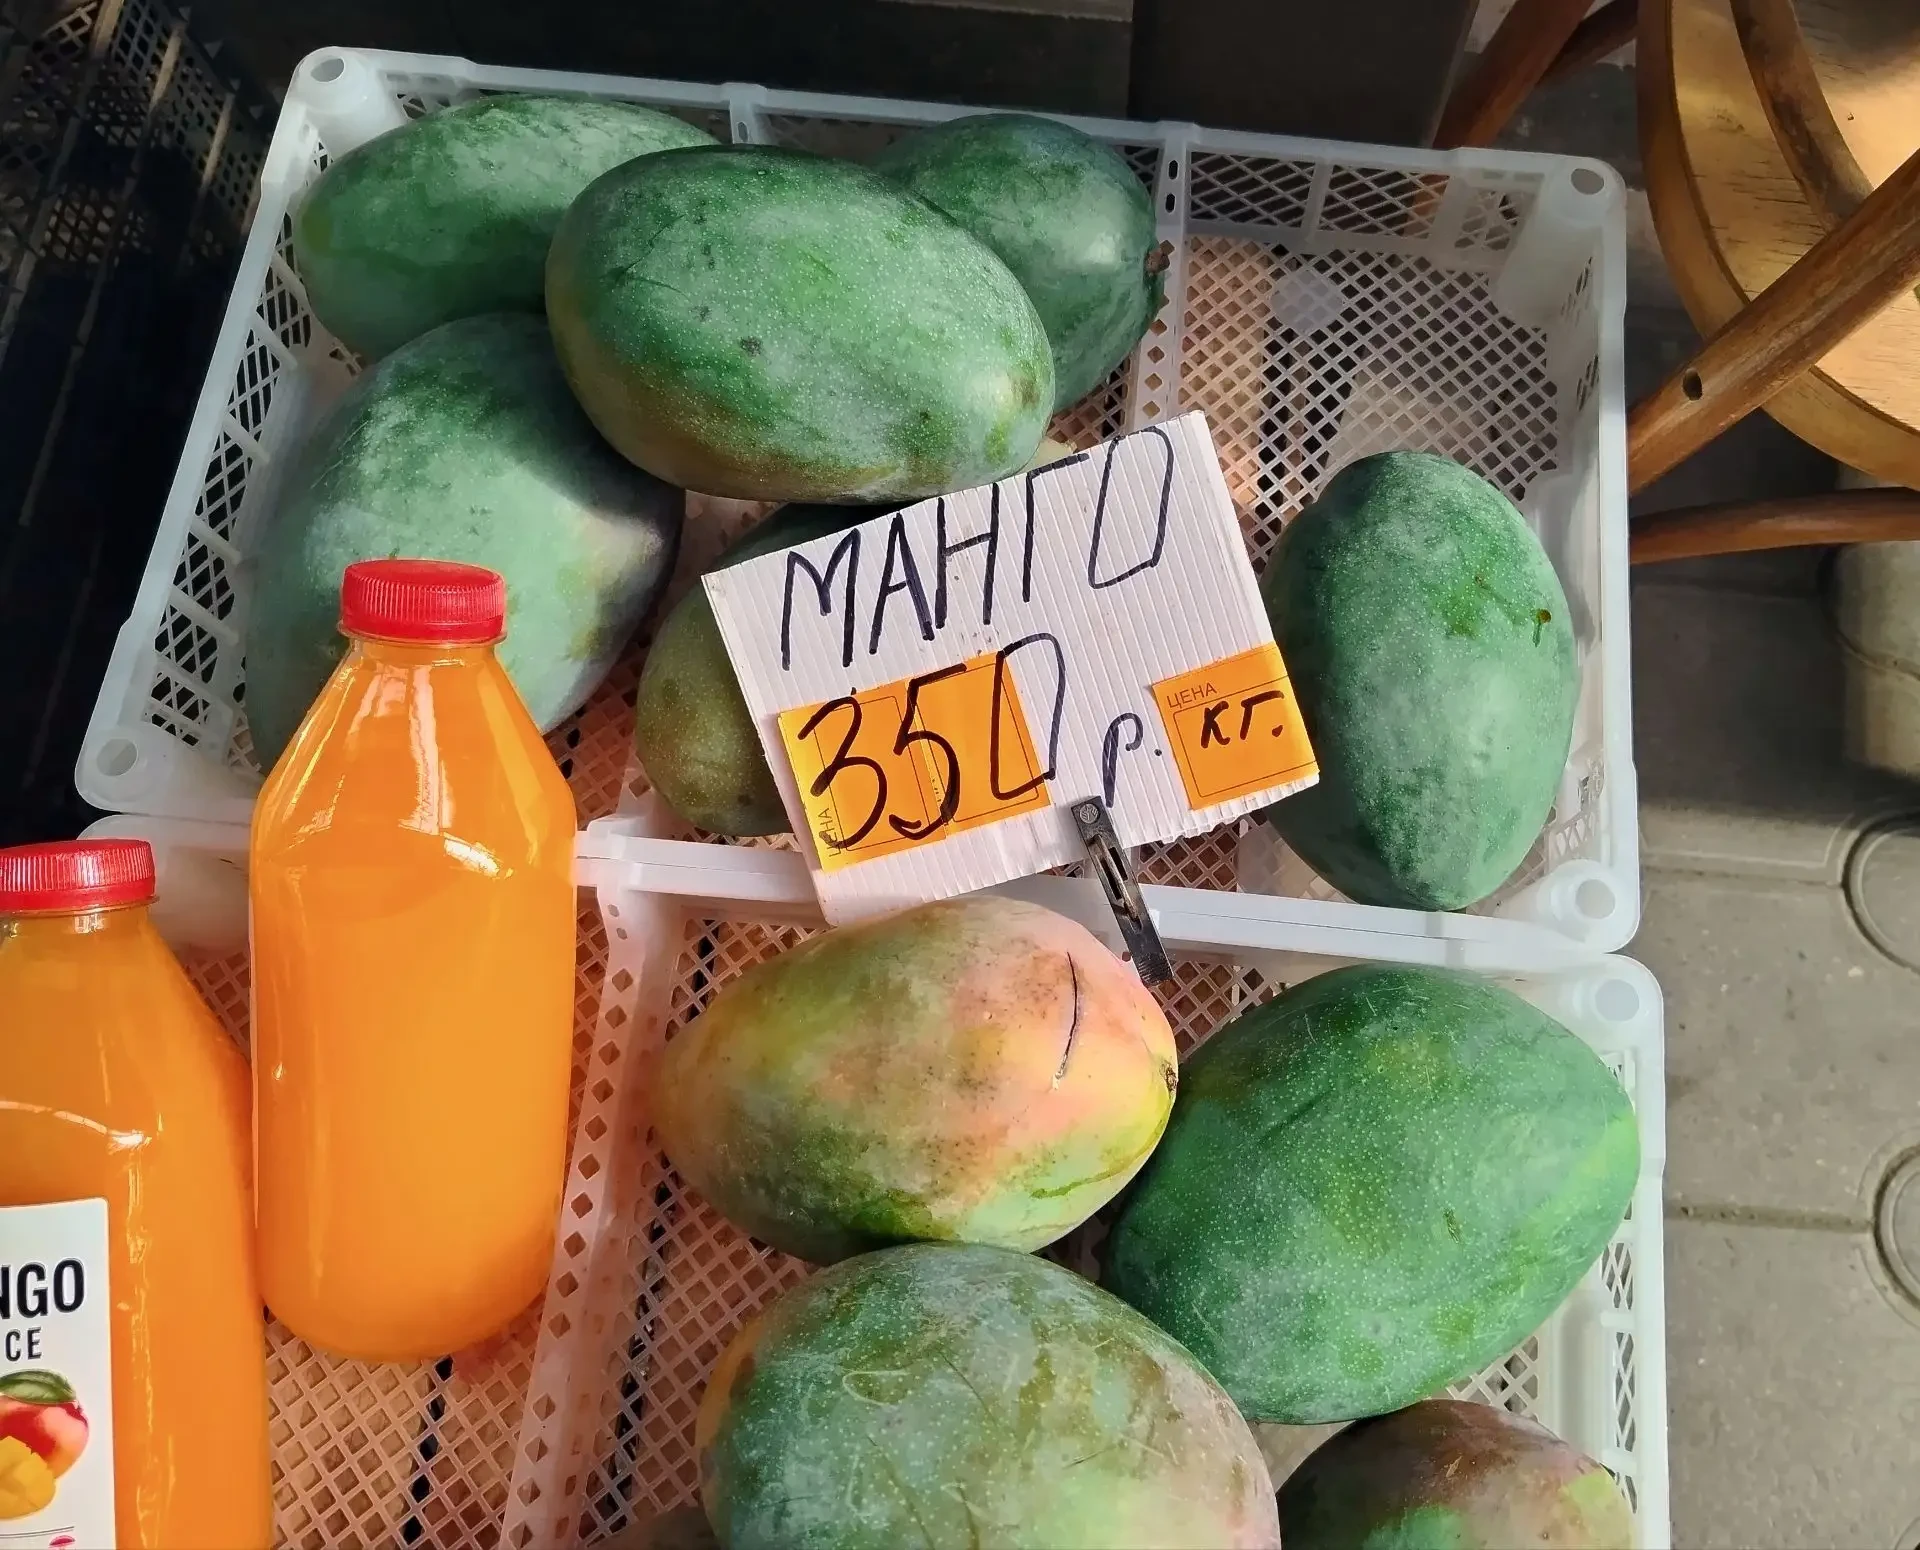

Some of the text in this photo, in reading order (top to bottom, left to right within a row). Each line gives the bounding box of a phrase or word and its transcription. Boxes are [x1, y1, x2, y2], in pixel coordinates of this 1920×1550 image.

[781, 426, 1175, 671] МАНГО
[798, 633, 1066, 849] 350
[1166, 682, 1218, 709] ЦЕНА
[5, 1326, 42, 1362] CE
